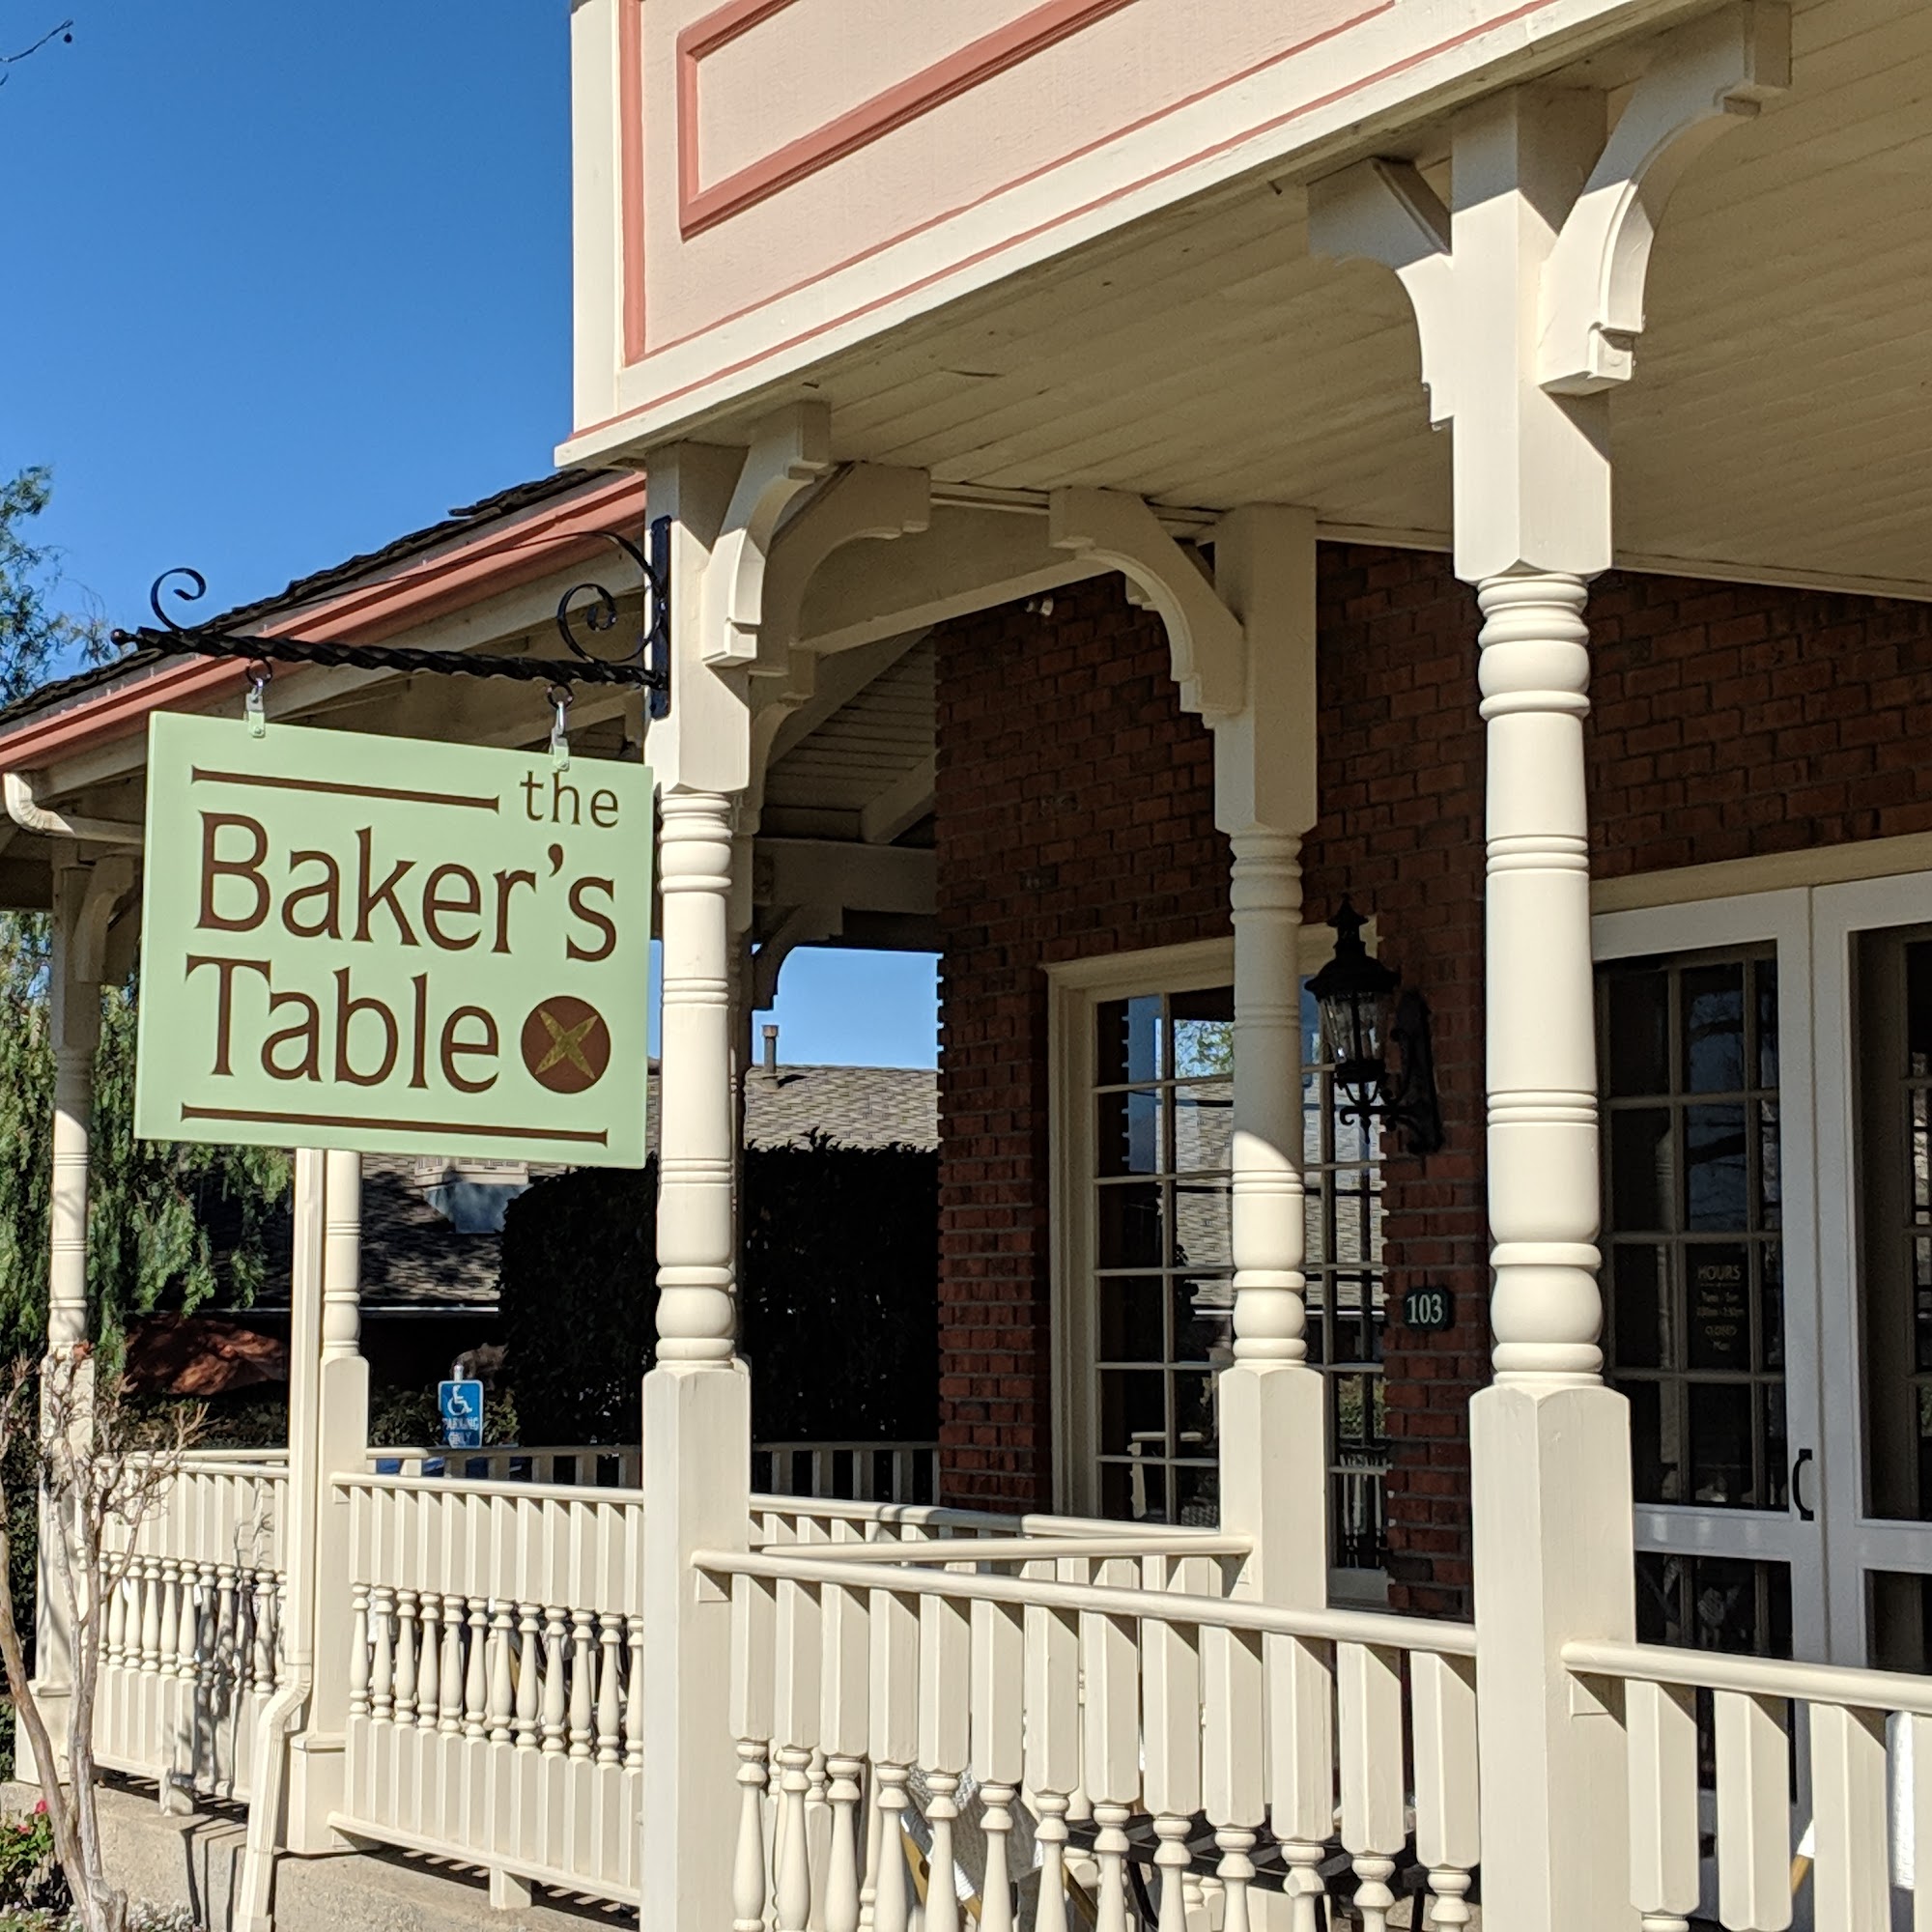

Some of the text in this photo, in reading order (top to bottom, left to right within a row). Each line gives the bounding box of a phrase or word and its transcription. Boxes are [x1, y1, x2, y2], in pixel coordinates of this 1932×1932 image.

[520, 771, 619, 828] the
[194, 810, 617, 962] Baker's
[185, 953, 500, 1094] Table
[1698, 1264, 1741, 1280] HOURS
[1406, 1293, 1442, 1323] 103
